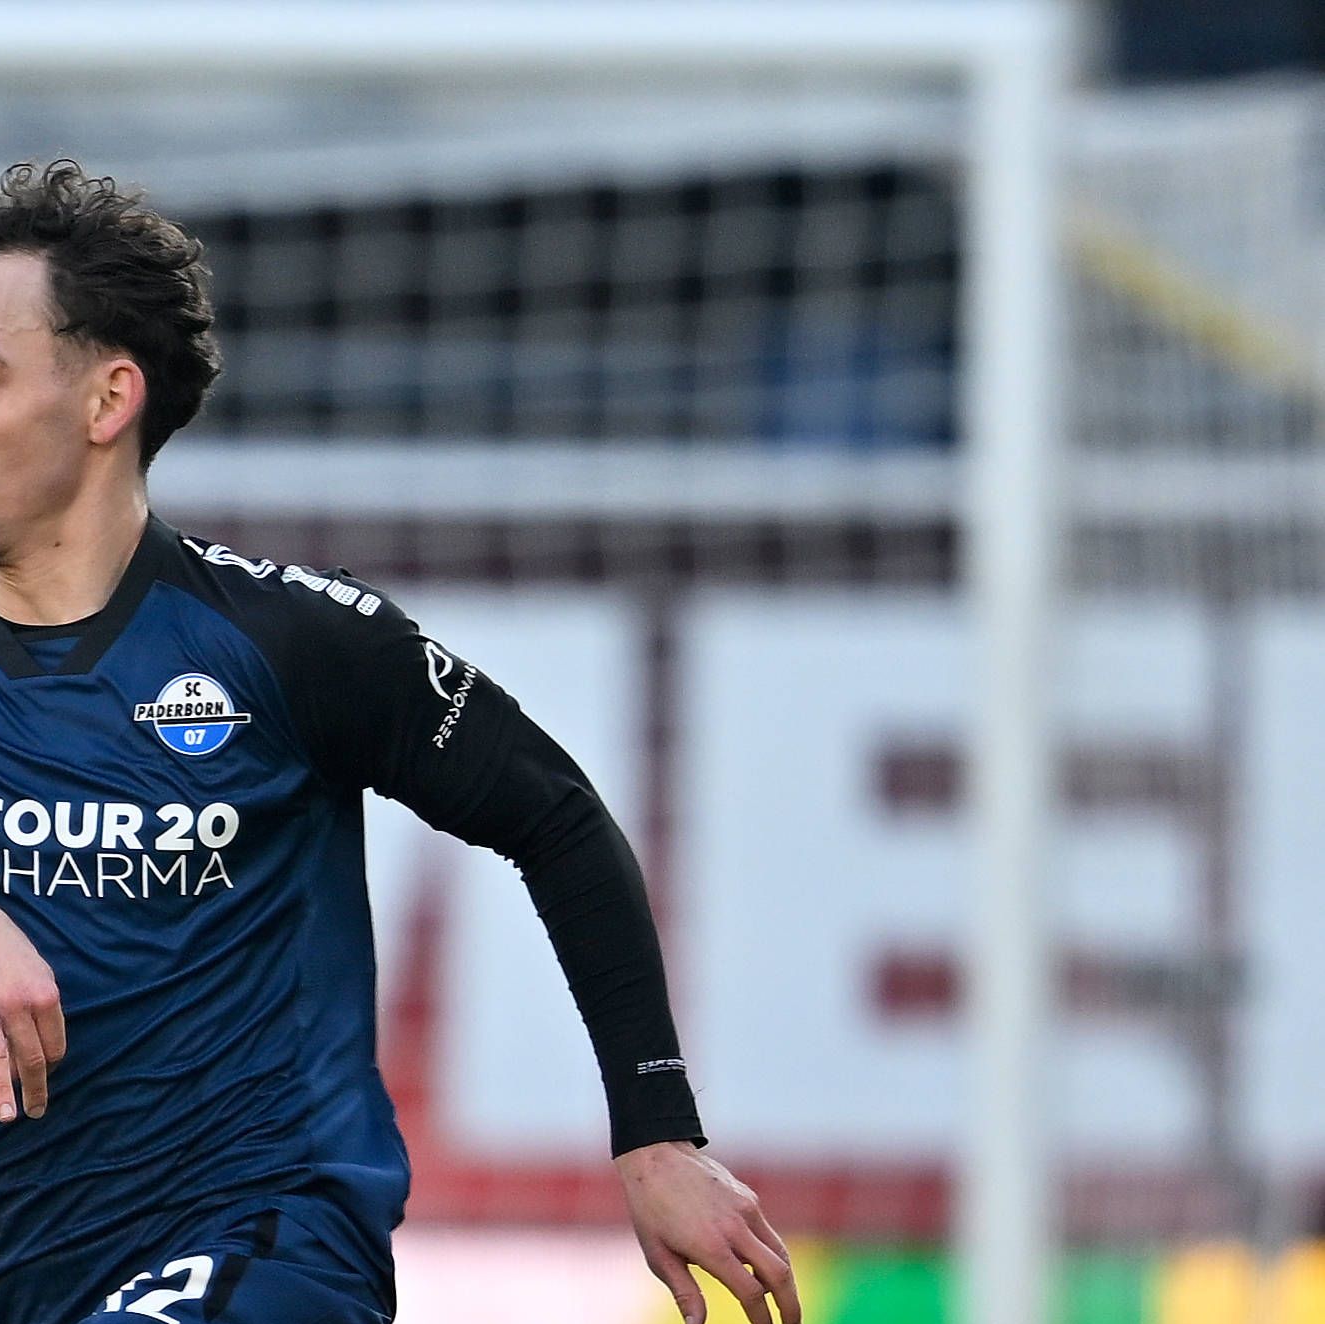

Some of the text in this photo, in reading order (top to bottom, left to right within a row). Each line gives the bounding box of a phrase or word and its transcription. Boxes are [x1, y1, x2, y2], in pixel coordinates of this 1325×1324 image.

[185, 681, 202, 697] SC
[137, 701, 224, 719] PADERBORN
[183, 729, 207, 746] 07
[155, 802, 240, 850] 20
